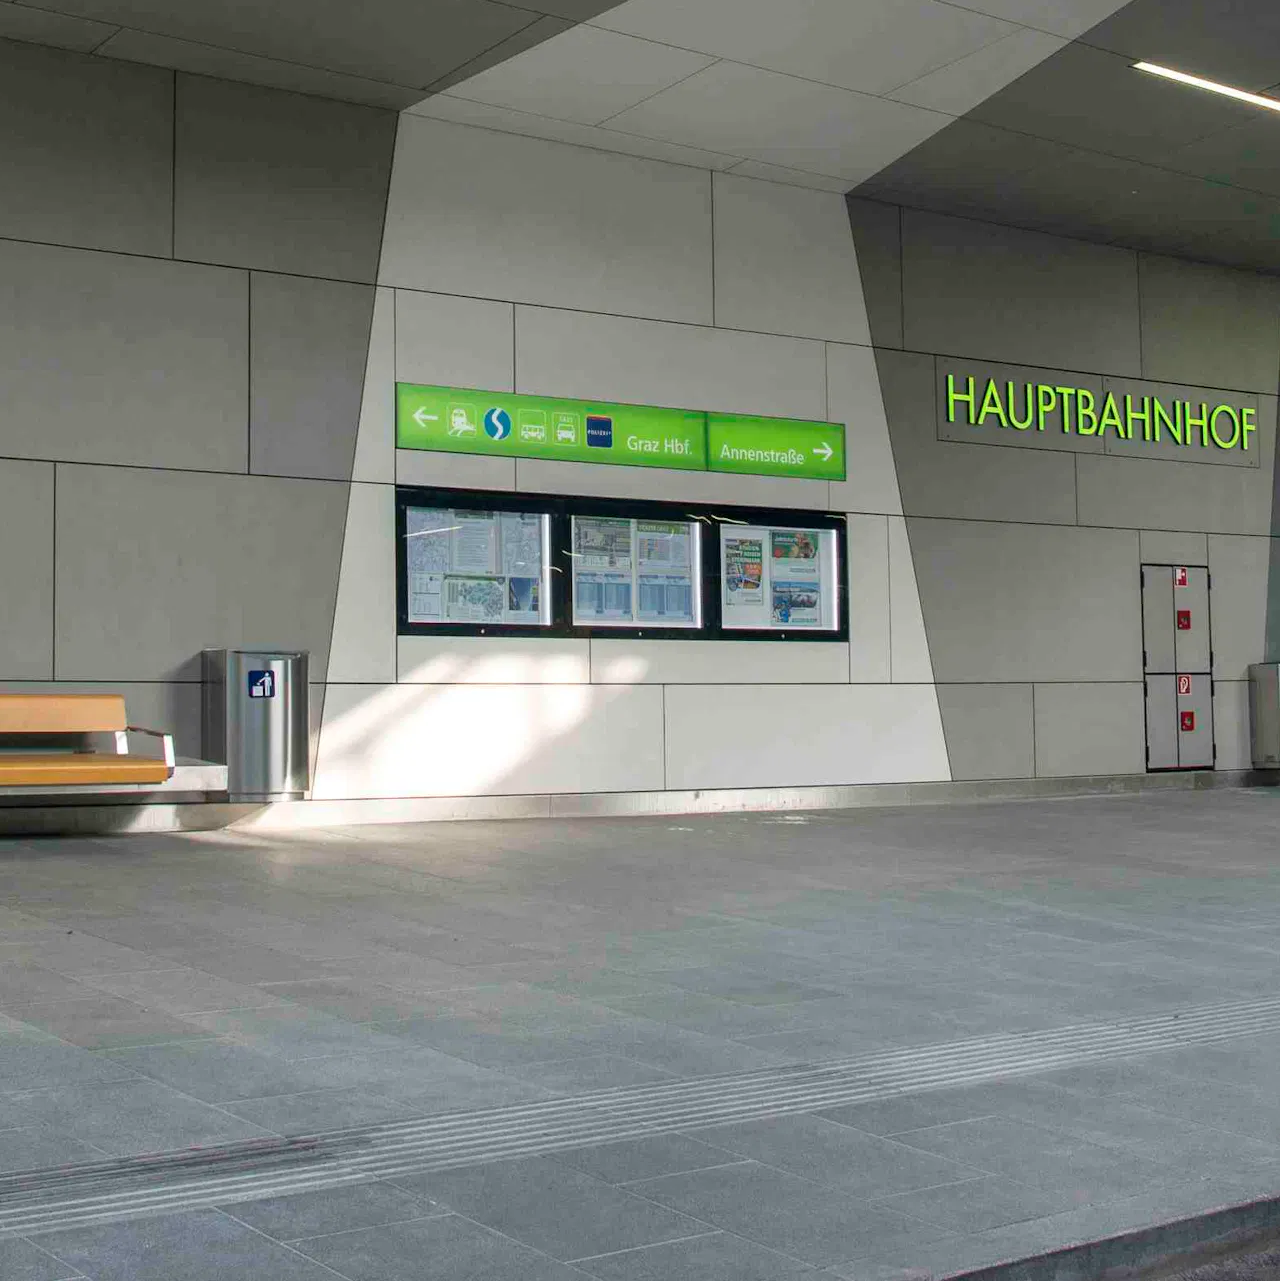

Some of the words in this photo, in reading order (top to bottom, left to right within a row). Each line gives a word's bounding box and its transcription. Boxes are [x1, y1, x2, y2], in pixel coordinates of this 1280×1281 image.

[946, 374, 1257, 451] HAUPTBAHNHOF
[627, 435, 659, 453] Graz
[664, 437, 693, 455] Hbf.
[720, 444, 805, 465] Annenstraße
